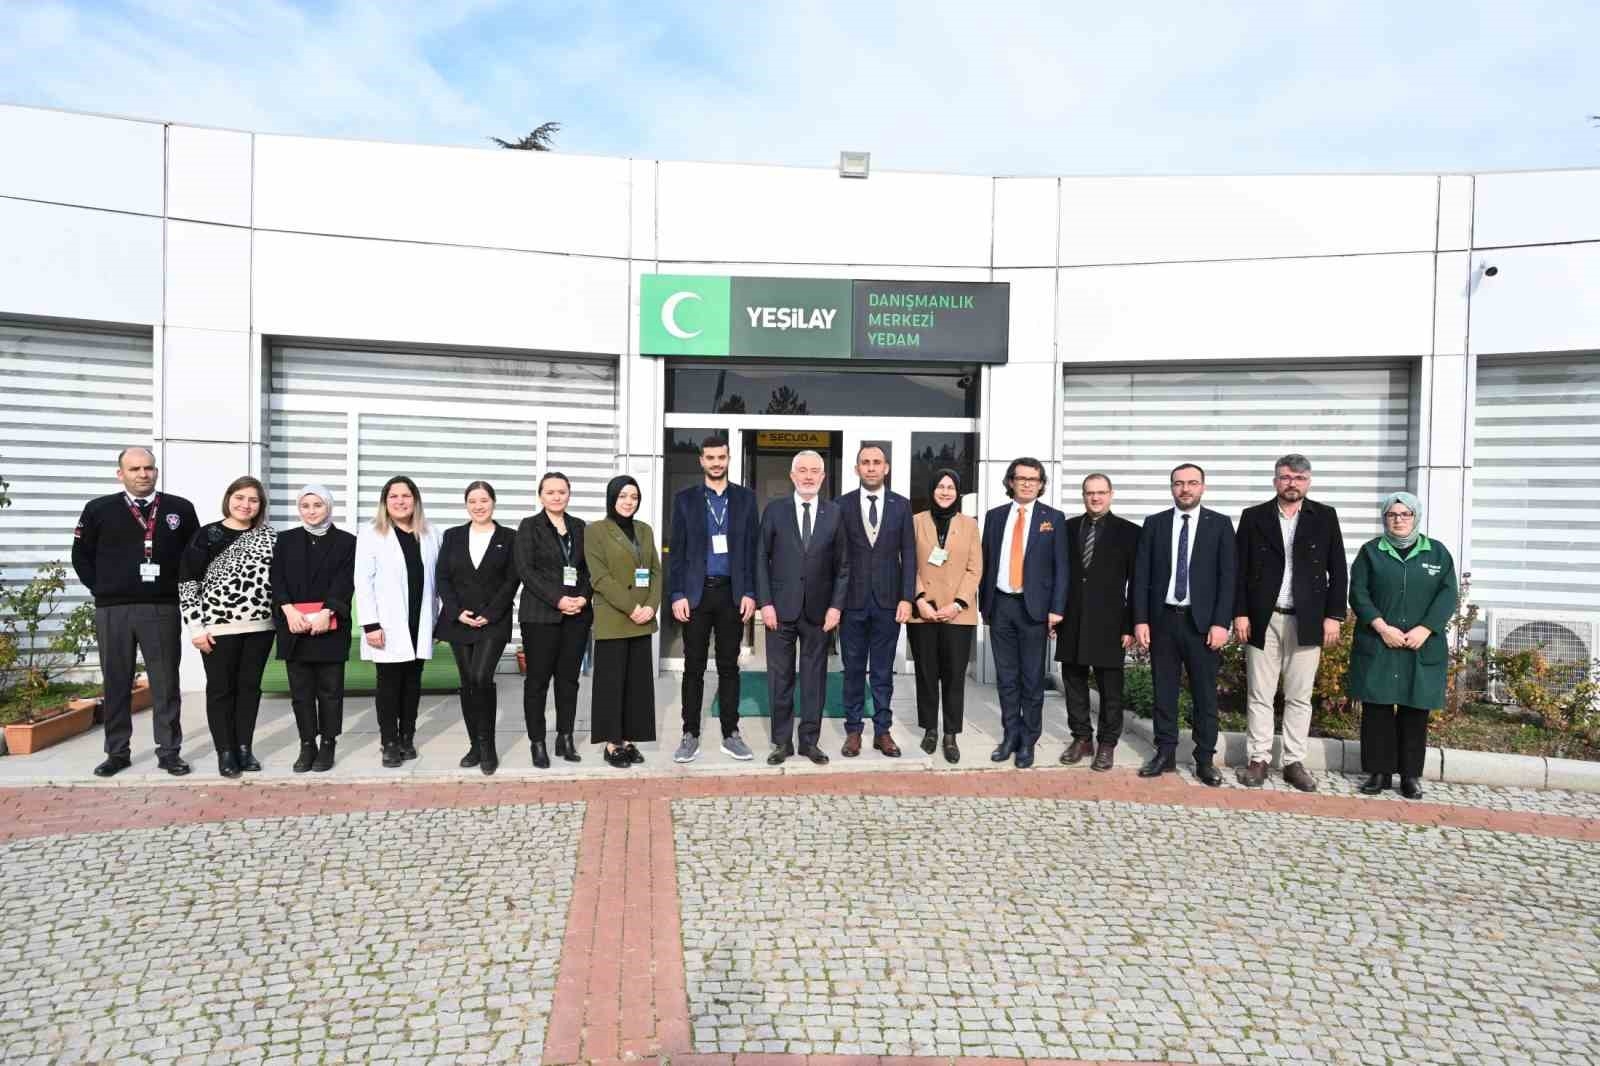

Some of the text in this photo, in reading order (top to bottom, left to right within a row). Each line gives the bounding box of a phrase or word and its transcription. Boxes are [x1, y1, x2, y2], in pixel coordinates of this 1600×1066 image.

[868, 294, 975, 311] DANIŞMANLIK
[868, 312, 935, 328] MERKEZİ
[868, 333, 920, 346] YEDAM
